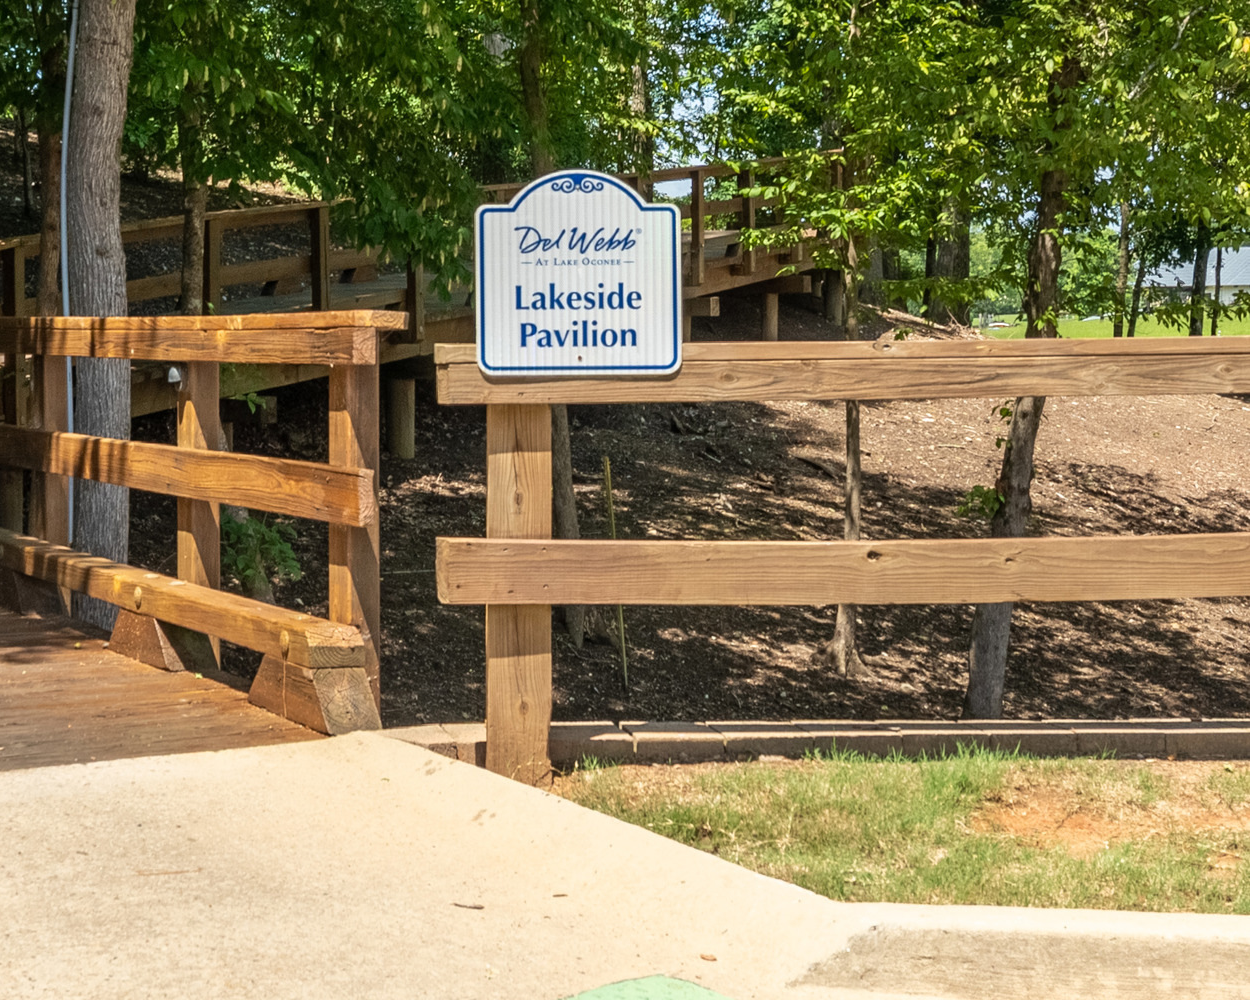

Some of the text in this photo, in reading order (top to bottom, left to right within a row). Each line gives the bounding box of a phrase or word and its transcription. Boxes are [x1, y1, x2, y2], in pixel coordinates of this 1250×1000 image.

[513, 226, 566, 254] Del
[535, 257, 621, 266] AT LAKE OCONEE
[515, 282, 642, 310] Lakeside
[520, 319, 637, 347] Pavilion
